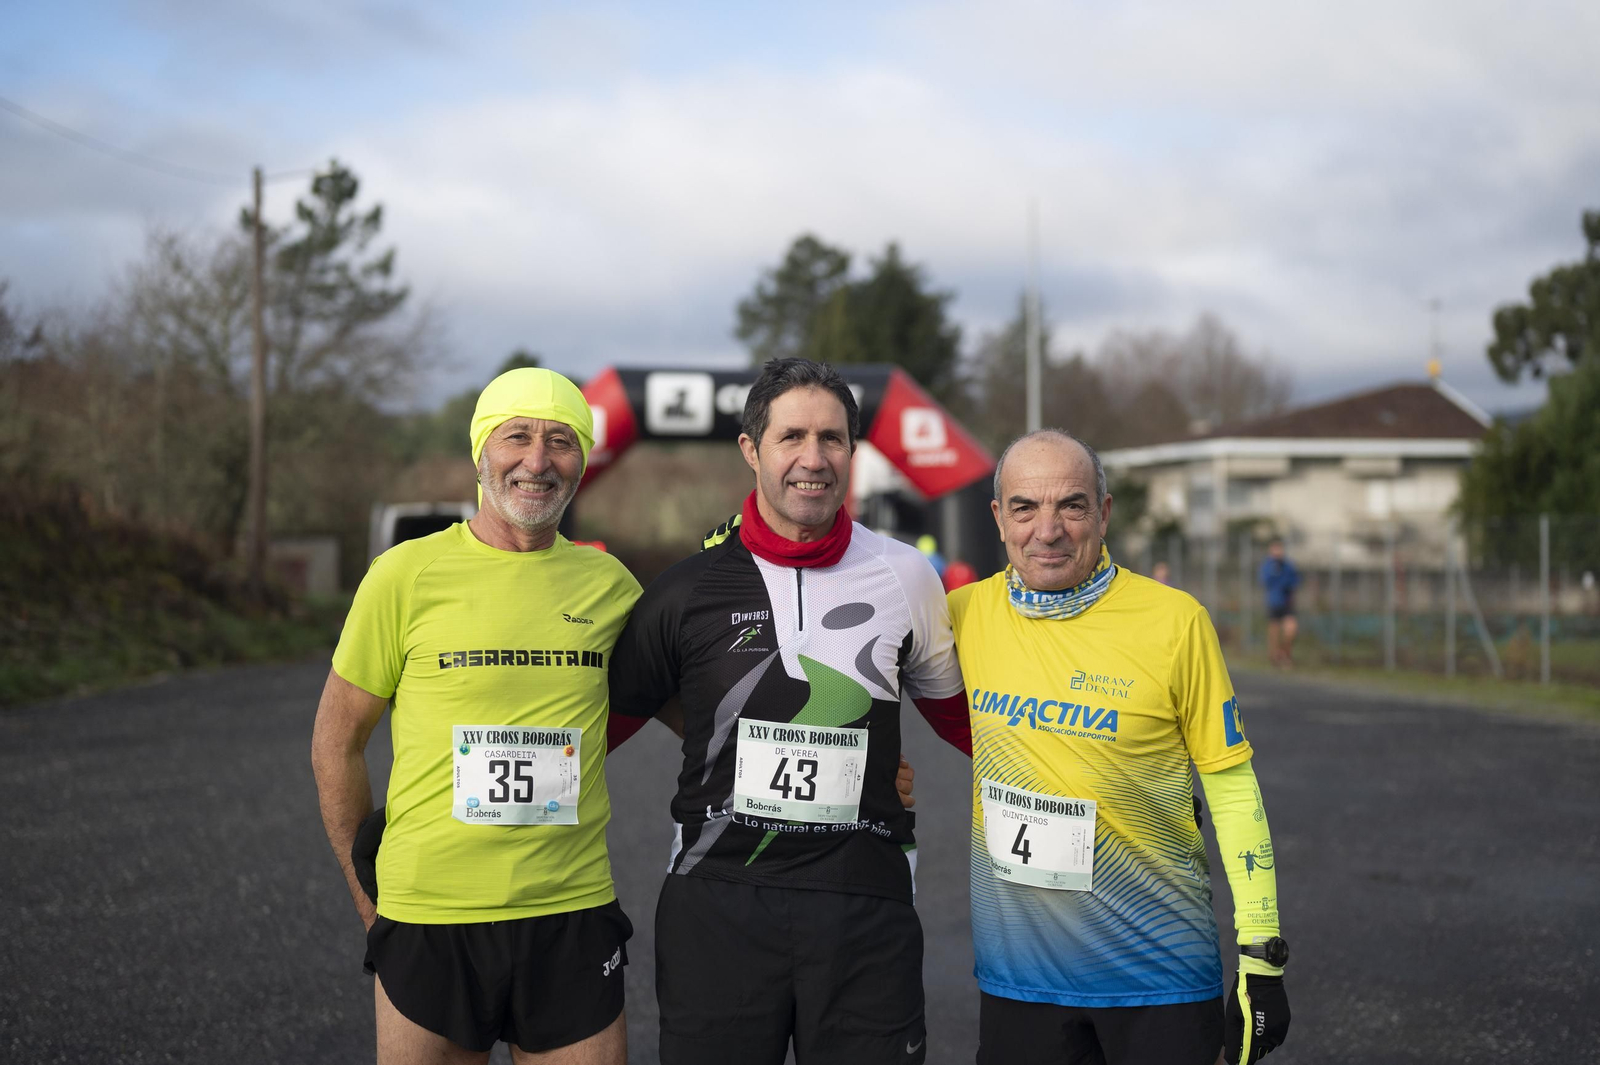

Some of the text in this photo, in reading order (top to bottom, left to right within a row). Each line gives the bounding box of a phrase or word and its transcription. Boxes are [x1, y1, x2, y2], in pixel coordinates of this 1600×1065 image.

[1087, 674, 1135, 688] ARRANZ
[1085, 683, 1132, 699] DENTAL
[972, 689, 1119, 733] LIMIACTIVA
[462, 730, 572, 746] XXV CROSS BOBORÁS
[748, 725, 859, 747] XXV CROSS BOBORÁS
[1037, 725, 1117, 742] ASOCIACIÓN DEPORTIVA
[484, 750, 537, 759] CASARDEITA
[775, 747, 818, 758] DE VEREA
[488, 760, 534, 803] 35
[769, 757, 818, 801] 43
[746, 798, 782, 813] Boborás
[988, 785, 1086, 817] XXV CROSS BOBORÁS
[744, 816, 759, 828] Lo
[763, 822, 809, 833] natural
[813, 825, 828, 833] es
[1001, 809, 1049, 826] QUINTAIROS
[1011, 823, 1032, 865] 4
